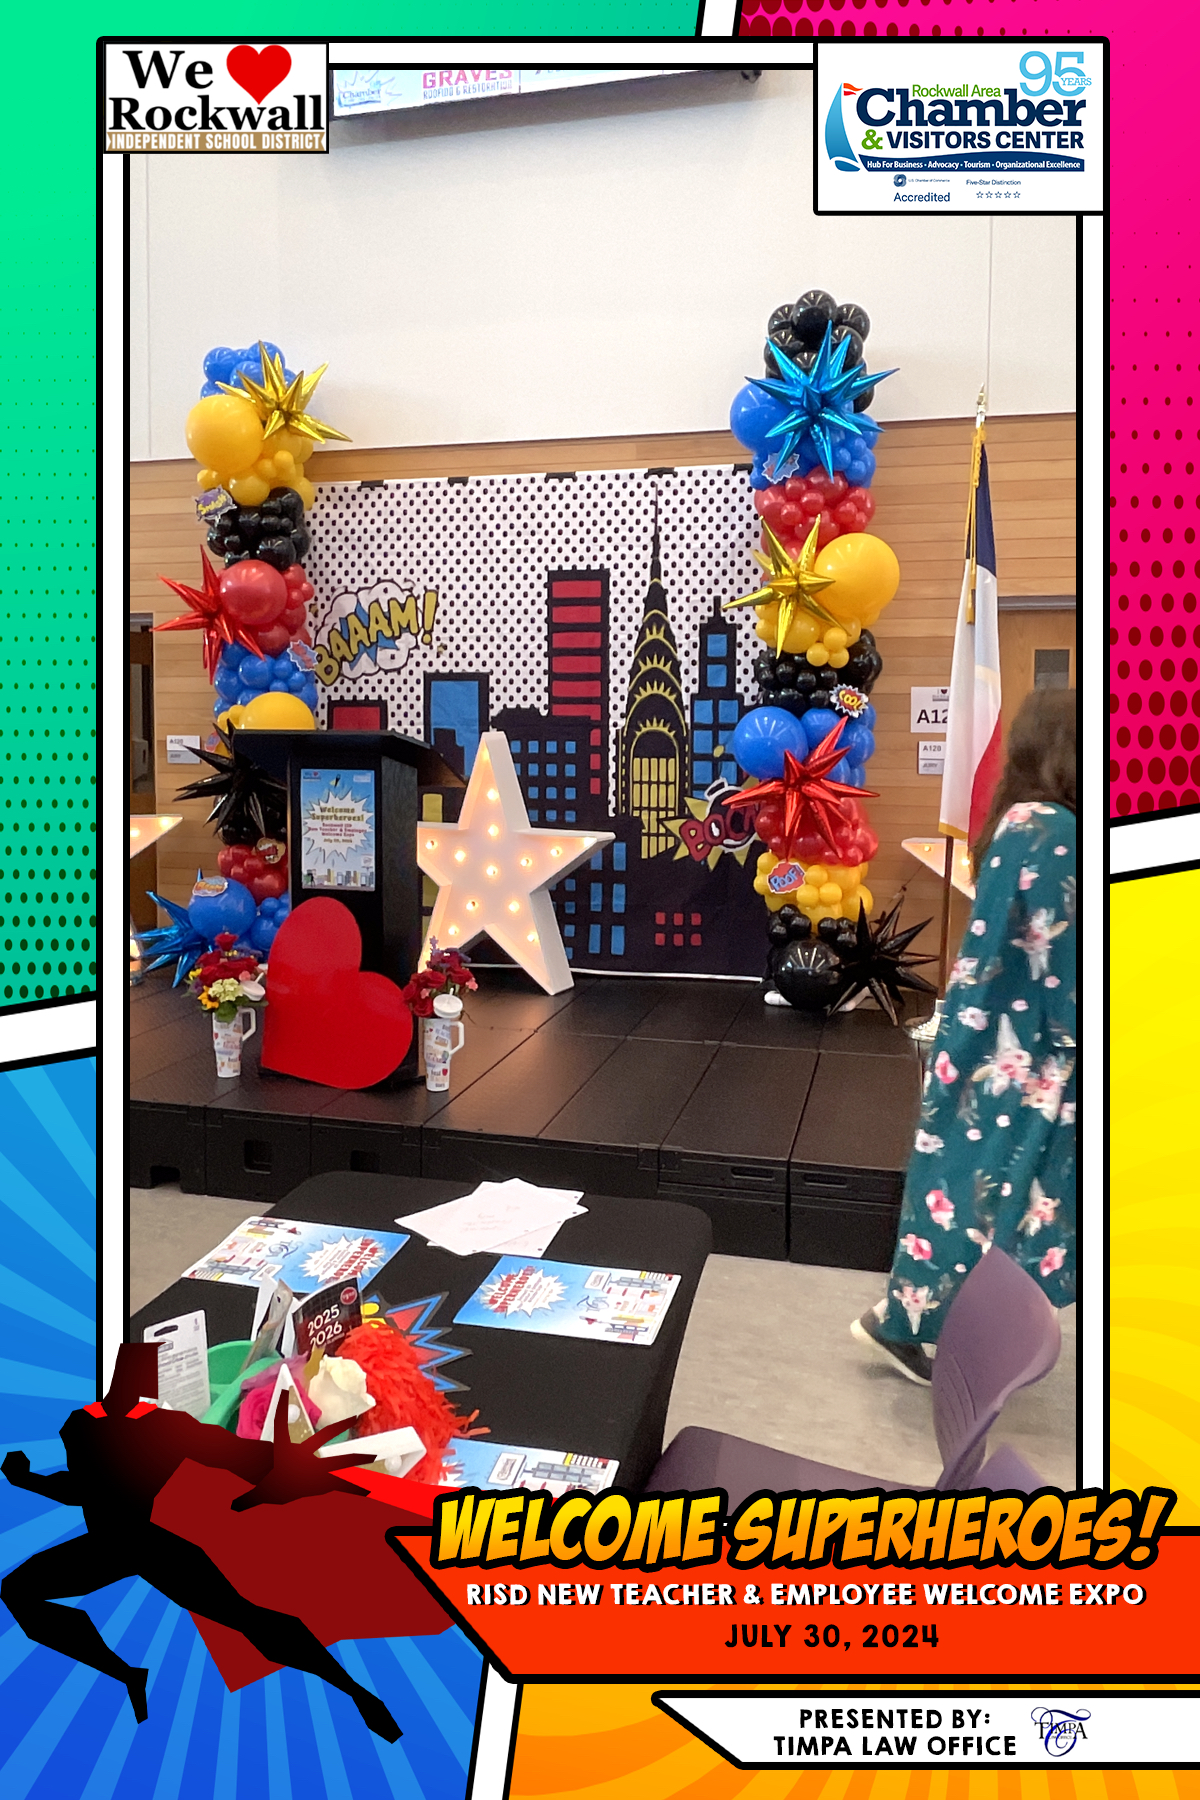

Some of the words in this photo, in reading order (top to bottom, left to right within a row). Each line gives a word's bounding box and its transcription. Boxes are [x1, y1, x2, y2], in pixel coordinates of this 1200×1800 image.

[422, 70, 512, 89] GRAVES
[314, 590, 437, 686] BAAAM!
[917, 709, 948, 724] A12
[769, 863, 804, 891] POOF!
[308, 1304, 340, 1337] 2025
[310, 1321, 342, 1345] 2026
